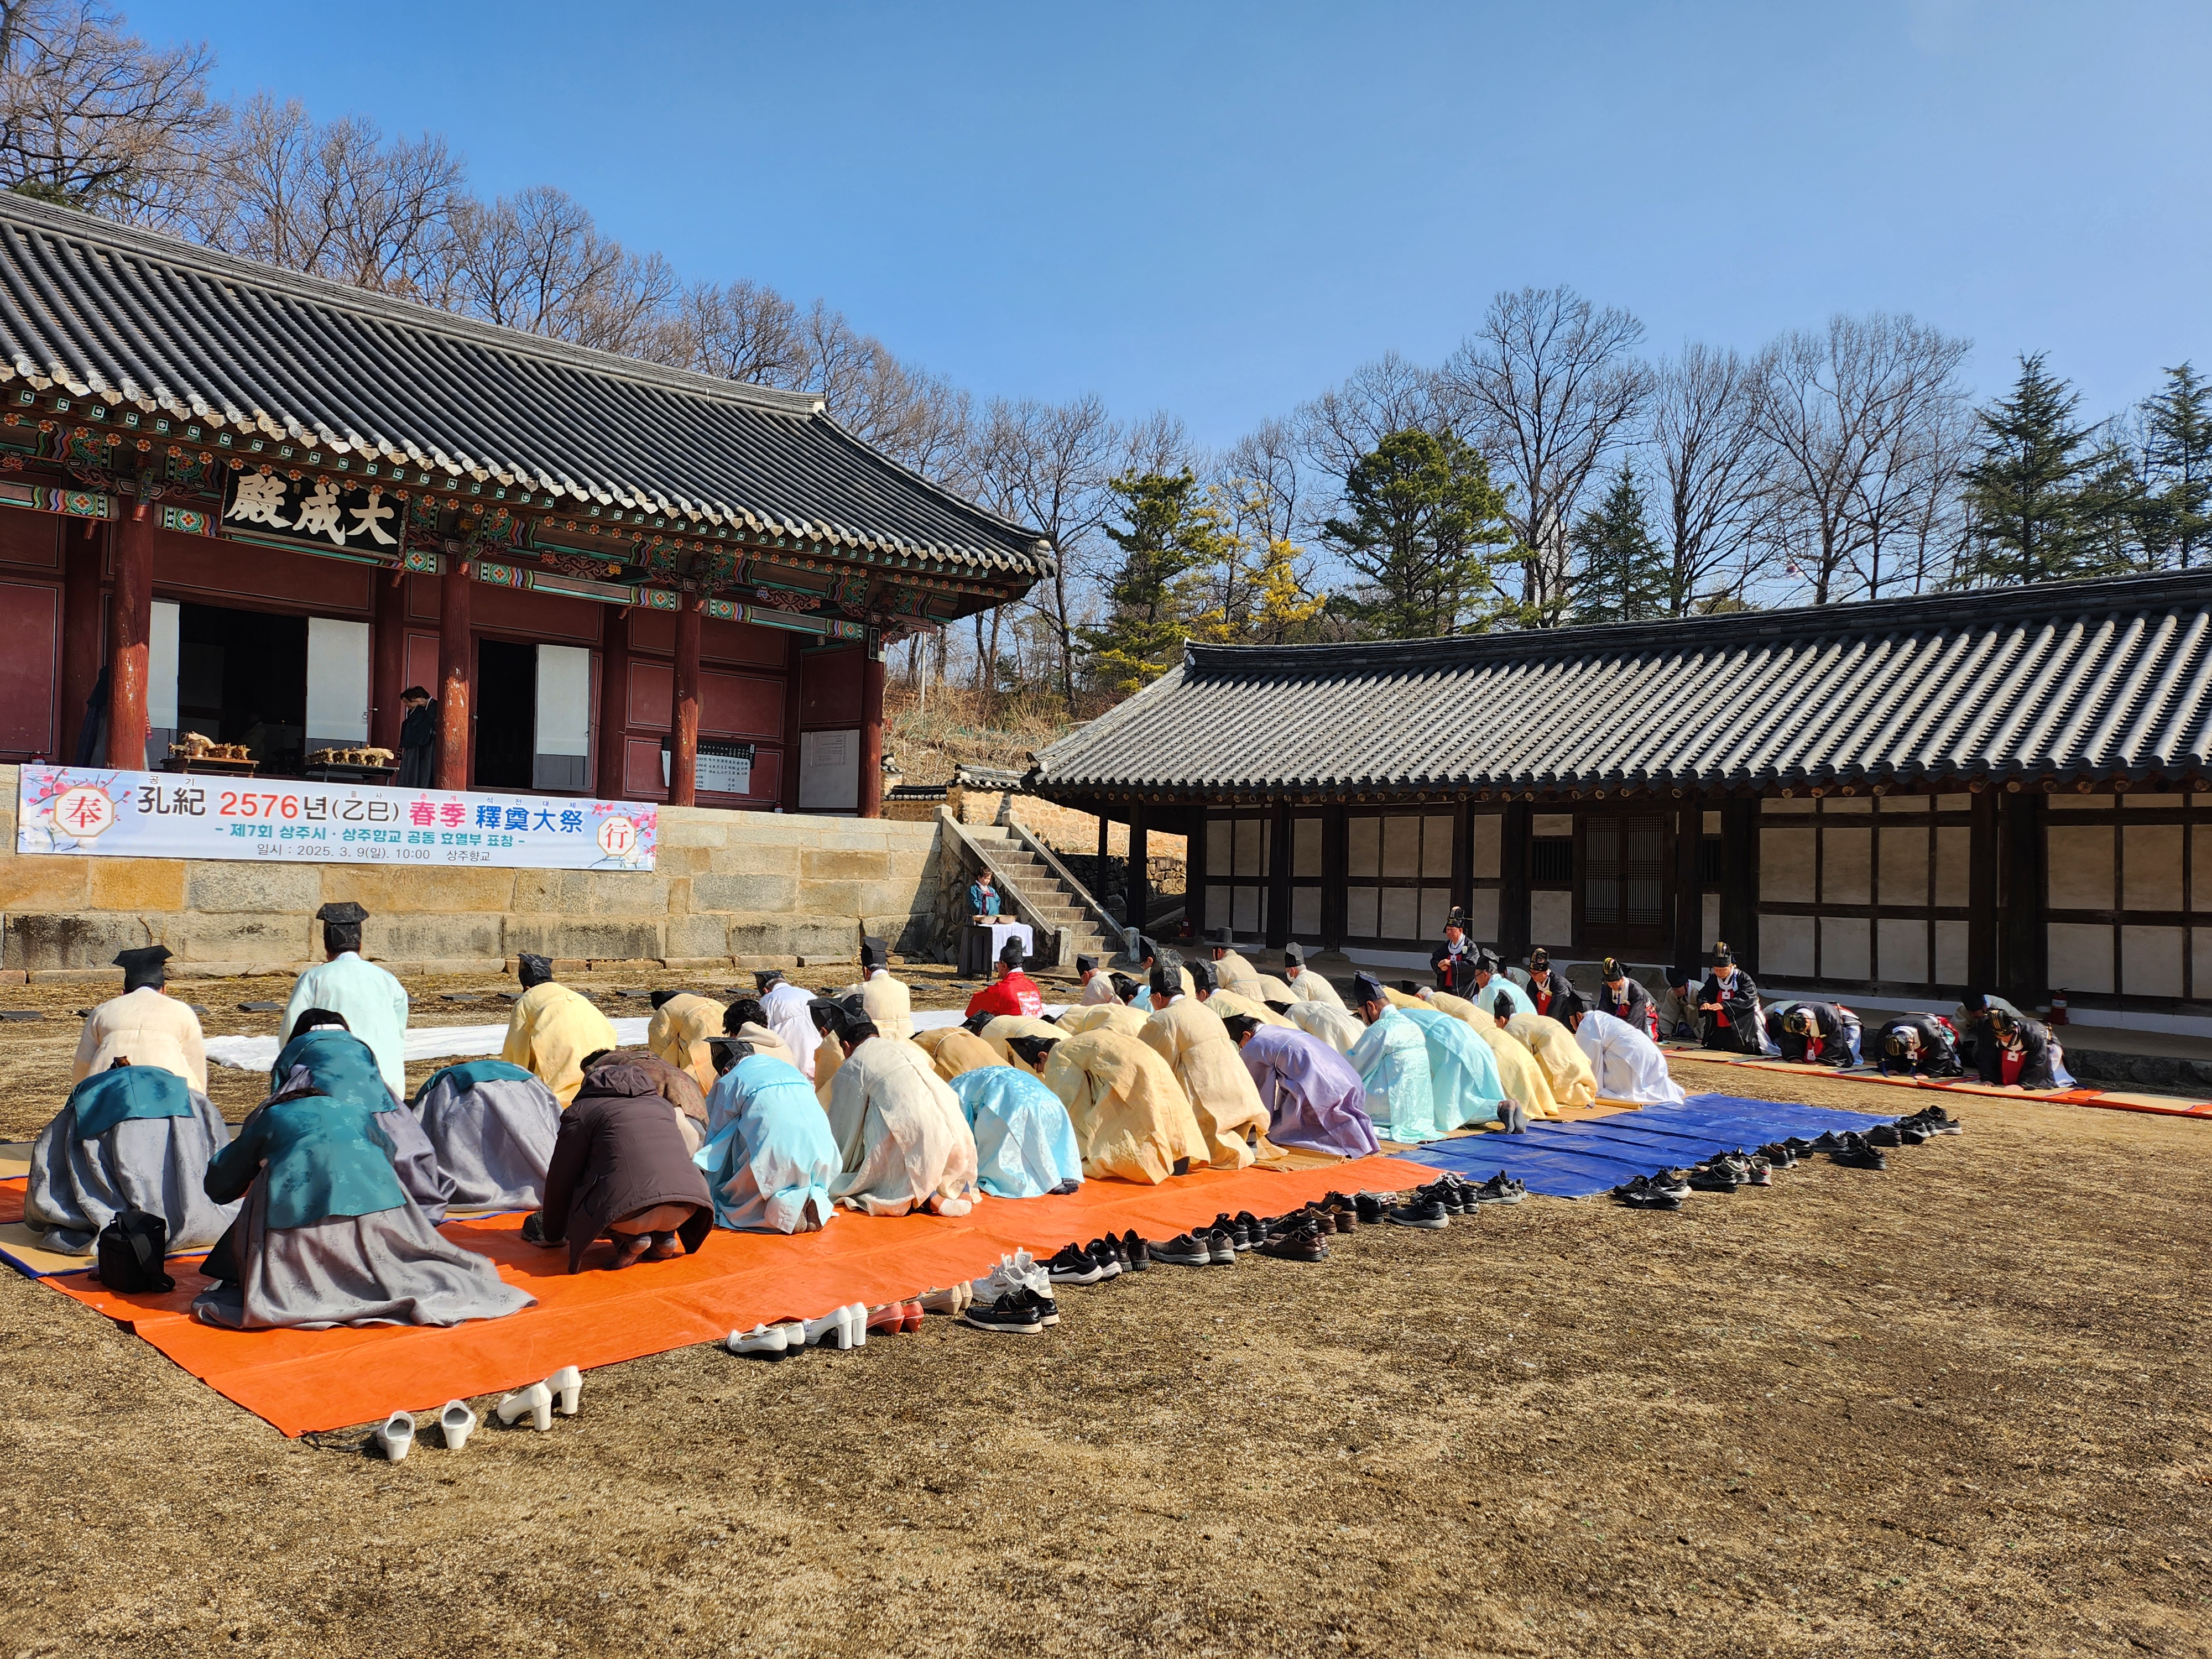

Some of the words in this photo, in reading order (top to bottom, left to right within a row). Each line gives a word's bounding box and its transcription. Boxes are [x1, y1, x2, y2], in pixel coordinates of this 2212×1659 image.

[65, 795, 103, 828] 奉
[138, 786, 206, 816] 孔紀
[409, 801, 467, 828] 春季
[230, 823, 273, 838] 제7회
[279, 826, 326, 840] 상주시
[342, 828, 401, 843] 상주향교
[408, 831, 436, 844] 공동
[441, 832, 482, 846] 효열부
[487, 834, 514, 847] 표창
[605, 823, 629, 849] 行
[396, 849, 430, 859] 10:00
[446, 850, 491, 862] 상주향교
